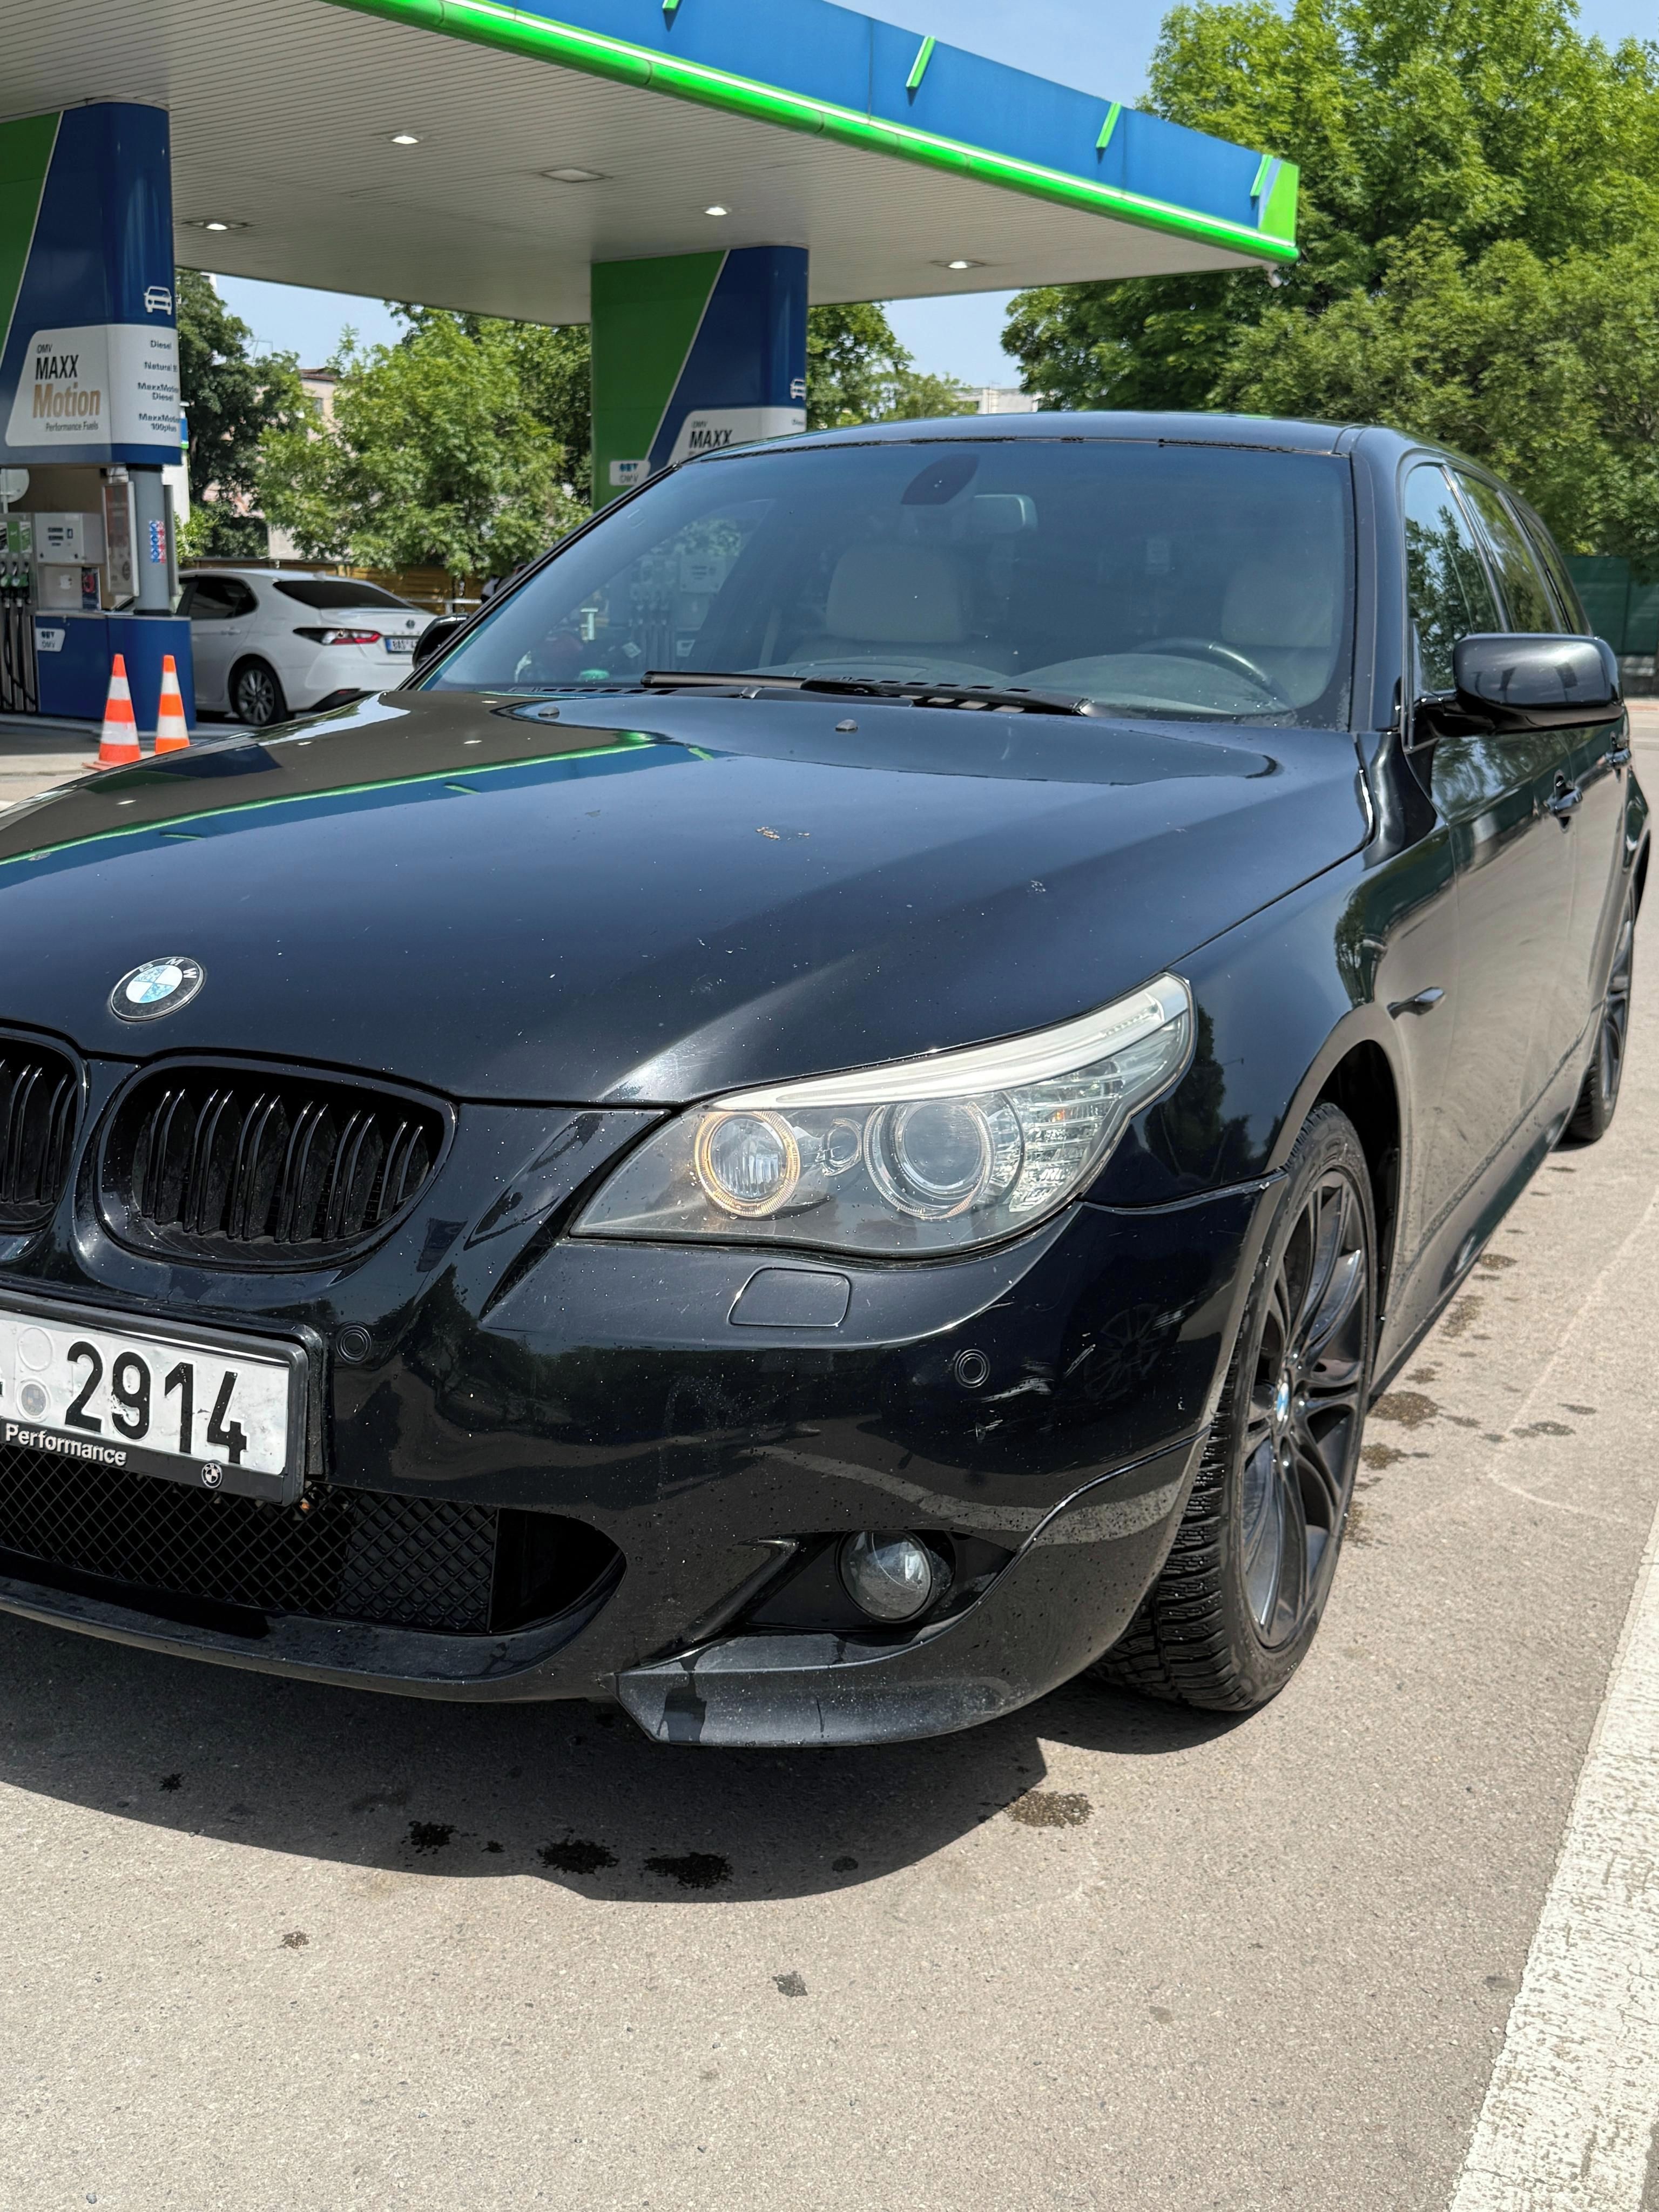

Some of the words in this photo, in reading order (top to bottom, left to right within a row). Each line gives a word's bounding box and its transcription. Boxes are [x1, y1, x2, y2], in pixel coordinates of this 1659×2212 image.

[37, 344, 52, 354] OMV
[150, 340, 172, 349] Diesel
[35, 355, 79, 380] MAXX
[33, 382, 100, 418] Motion
[689, 430, 732, 448] MAXX
[139, 958, 197, 979] BMW
[65, 1341, 247, 1464] 2914
[6, 1423, 126, 1466] Performance
